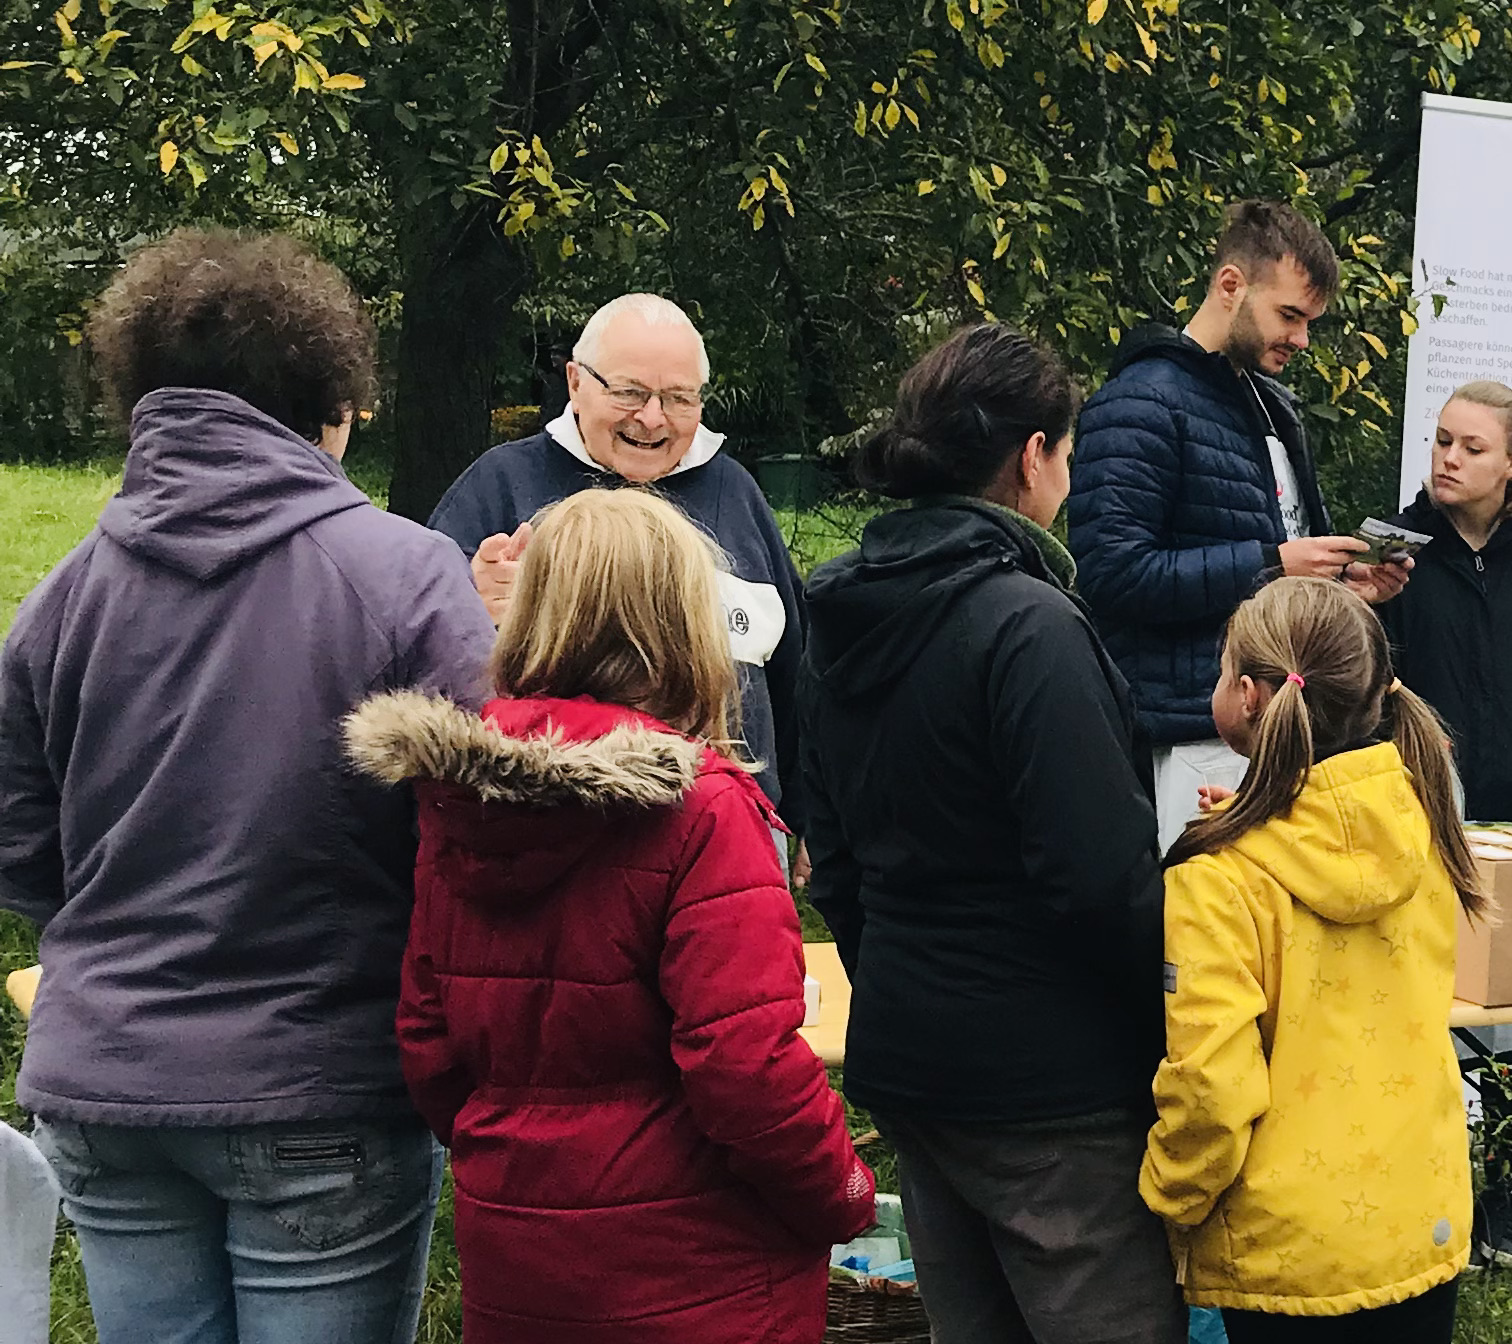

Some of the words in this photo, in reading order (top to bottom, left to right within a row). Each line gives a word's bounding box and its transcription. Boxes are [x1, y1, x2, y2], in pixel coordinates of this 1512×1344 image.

[1432, 264, 1457, 278] Slow
[1459, 266, 1485, 281] Food
[1487, 269, 1504, 283] hat
[1431, 278, 1494, 296] Geschmacks
[1437, 294, 1489, 311] sterben
[1429, 311, 1487, 327] geschaffen.
[1427, 334, 1483, 352] Passagiere
[1426, 351, 1472, 367] pflanzen
[1474, 355, 1494, 368] und
[1426, 365, 1508, 384] Küchentradition
[1425, 381, 1448, 395] eine
